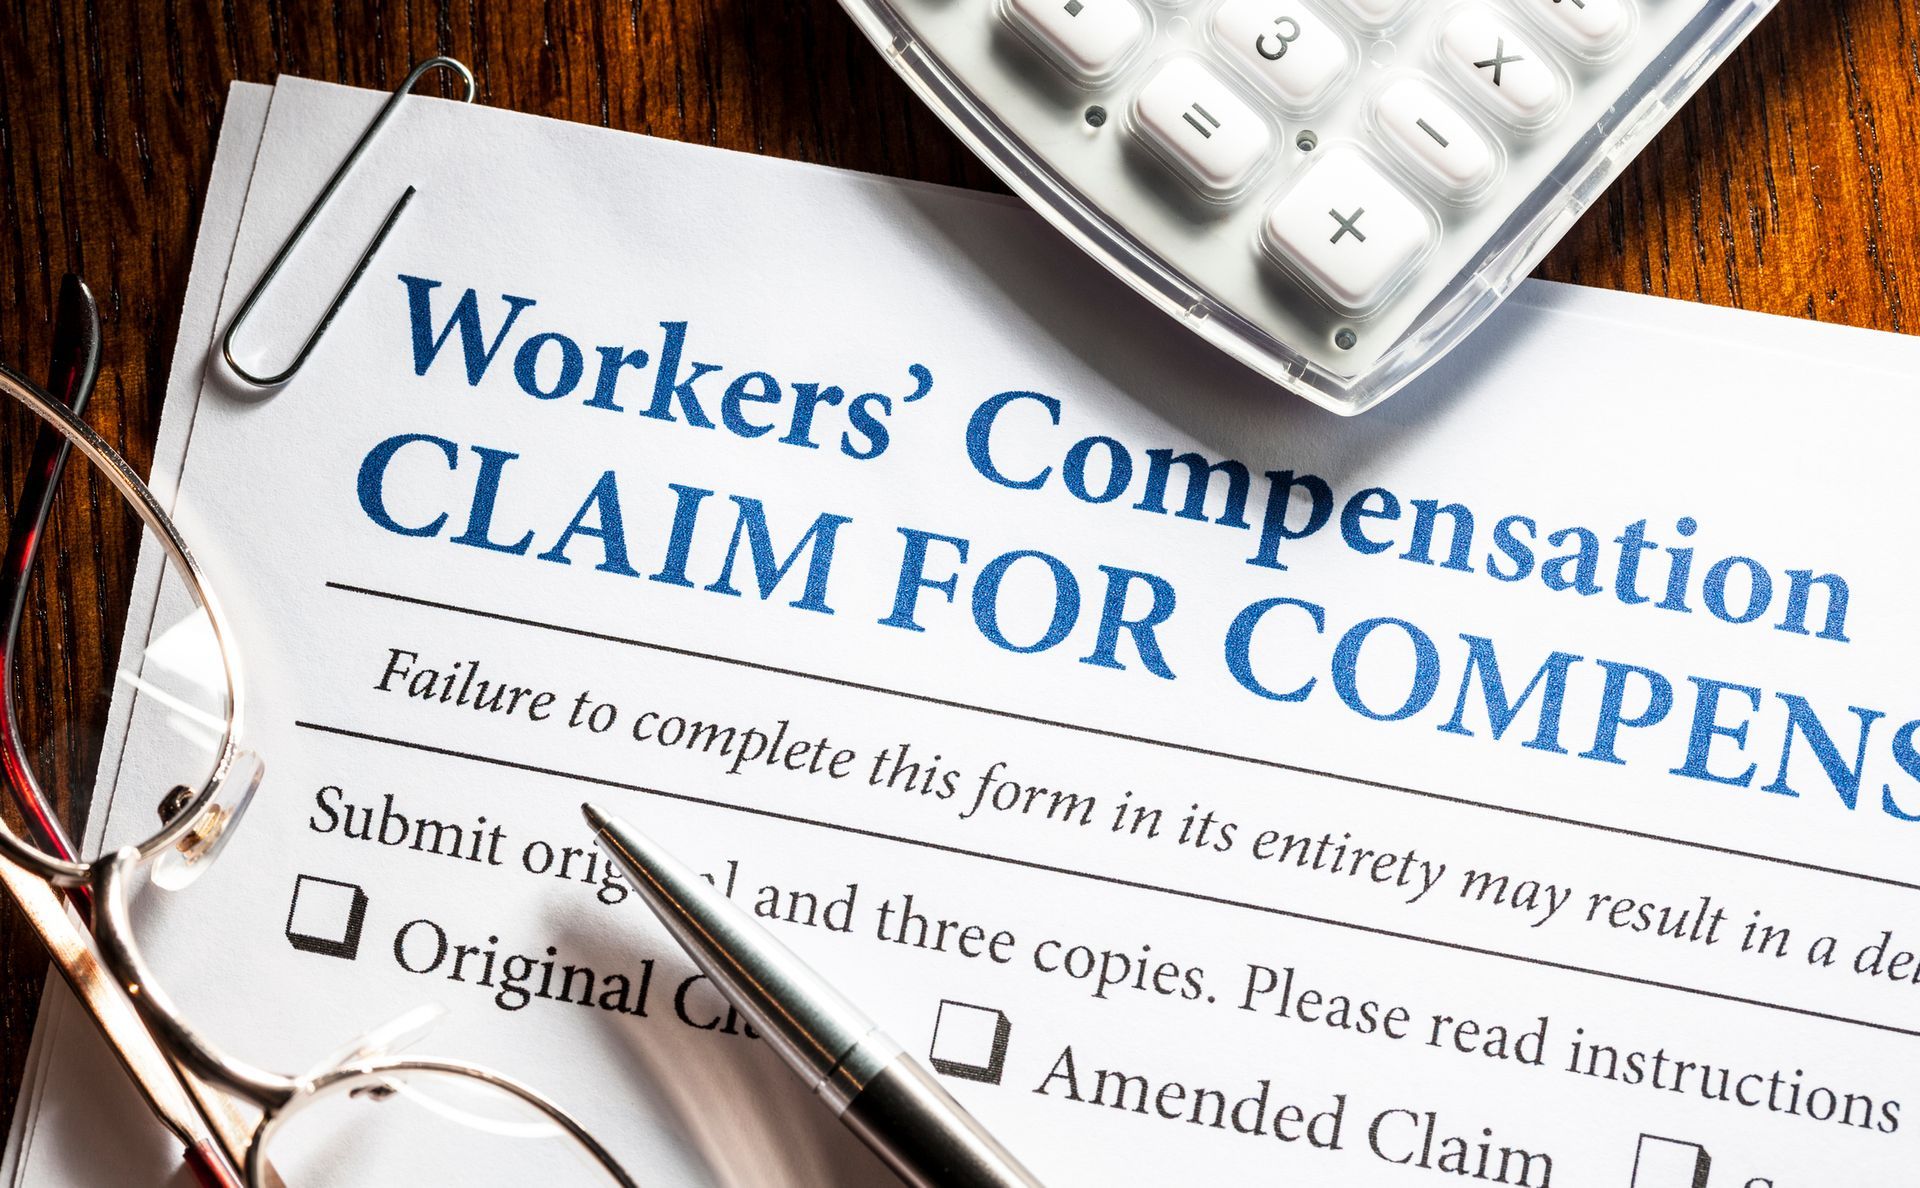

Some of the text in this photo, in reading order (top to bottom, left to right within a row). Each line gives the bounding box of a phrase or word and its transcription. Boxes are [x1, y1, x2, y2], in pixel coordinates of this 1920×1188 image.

[1256, 16, 1300, 60] 3
[357, 433, 1920, 822] CLAIM FOR COMPENS
[966, 391, 1850, 643] Compensation
[373, 648, 556, 721] Failure
[569, 691, 617, 733] to
[633, 712, 855, 779] complete
[869, 744, 960, 799] this
[959, 762, 1095, 826] form
[1112, 791, 1162, 839] in
[1179, 803, 1237, 852] its
[1253, 831, 1446, 904] entirety
[1460, 870, 1571, 927] may
[1586, 894, 1727, 945] result
[1742, 910, 1790, 958] in
[1808, 937, 1837, 967] a
[310, 786, 1900, 1133] Submit origl and three copies. Please read instructions
[393, 919, 654, 1018] Original
[1032, 1045, 1552, 1188] Amended Claim
